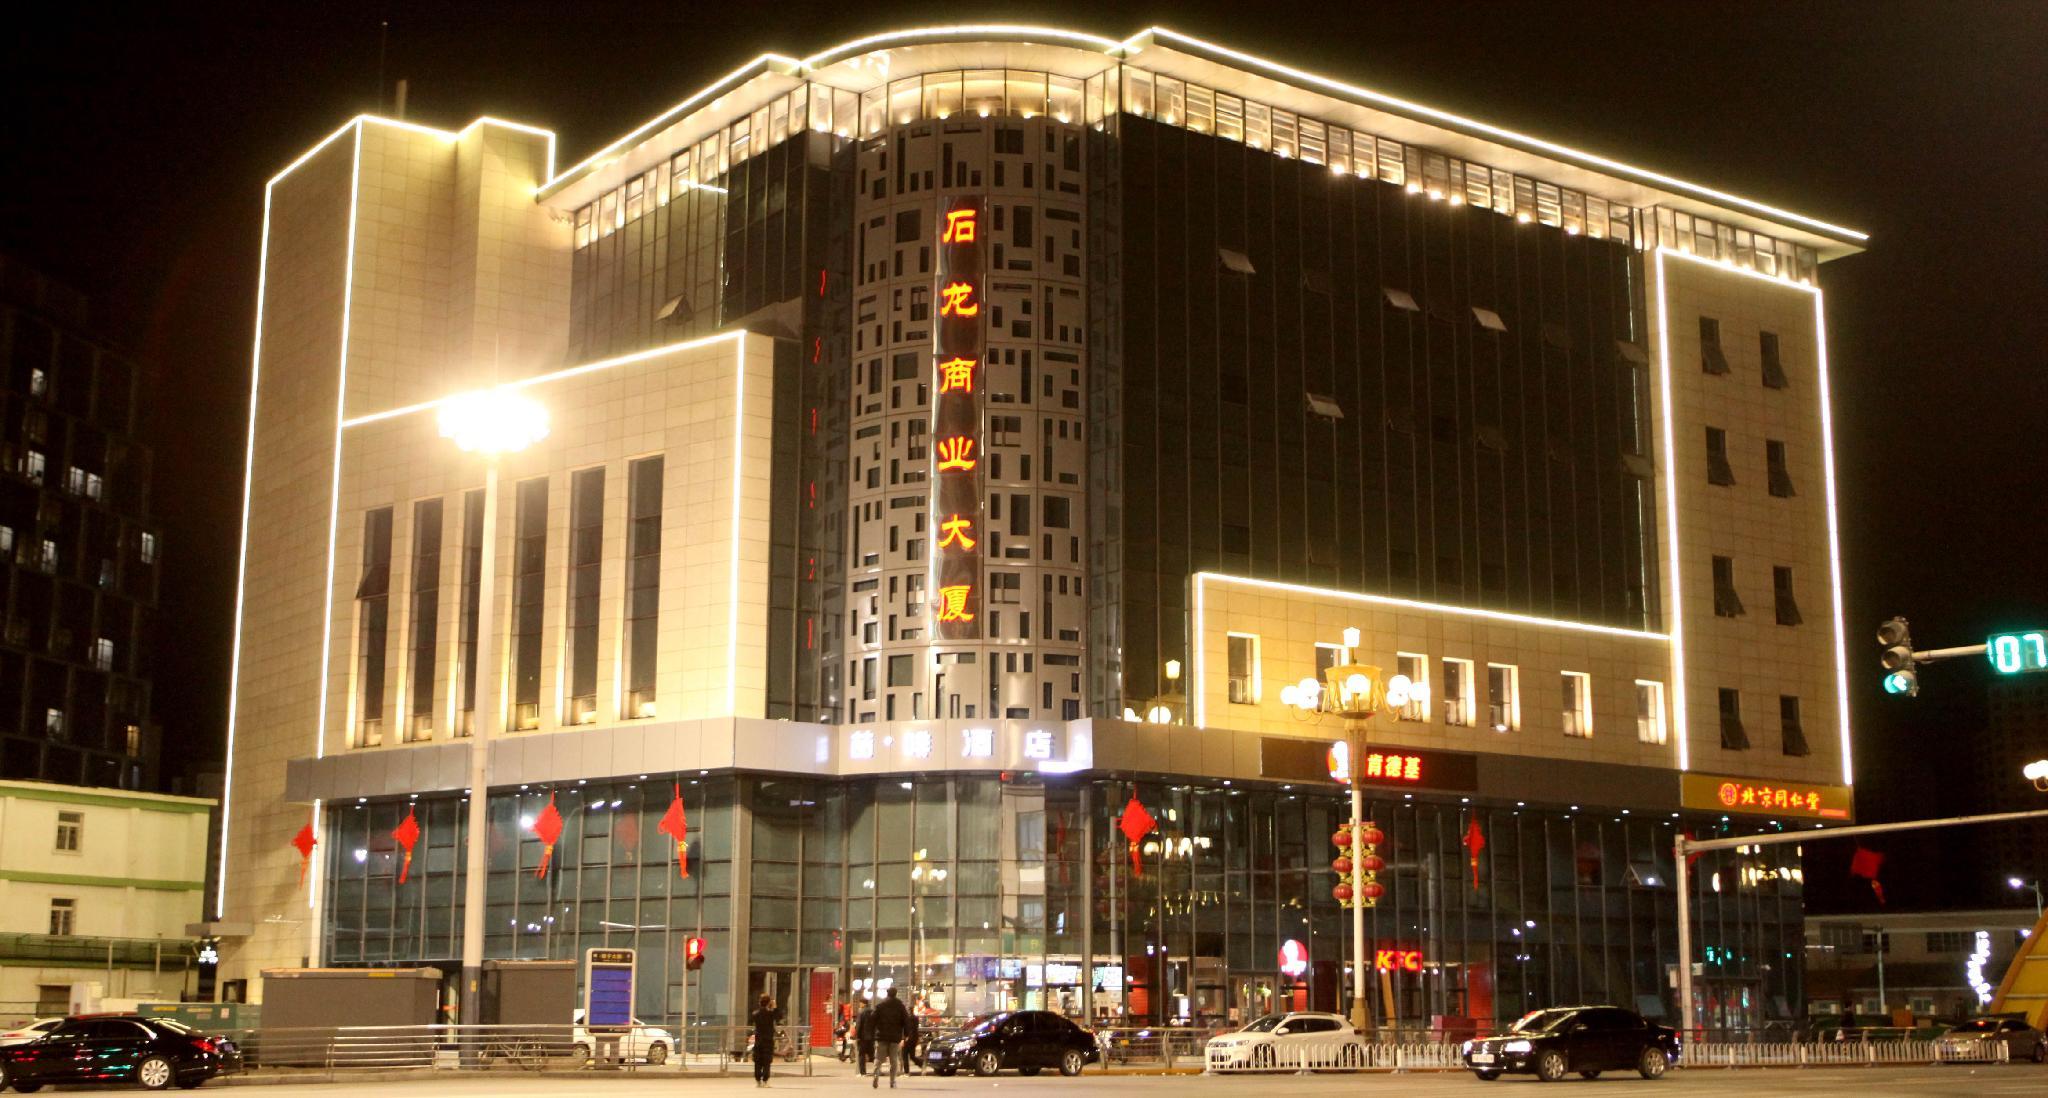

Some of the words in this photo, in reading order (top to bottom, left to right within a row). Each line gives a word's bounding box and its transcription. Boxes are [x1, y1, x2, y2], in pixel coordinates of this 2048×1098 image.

[938, 208, 979, 624] 石龙商业大厦
[1995, 634, 2047, 672] 07
[1366, 753, 1421, 779] 肯德基
[1740, 786, 1820, 810] 北京同仁堂
